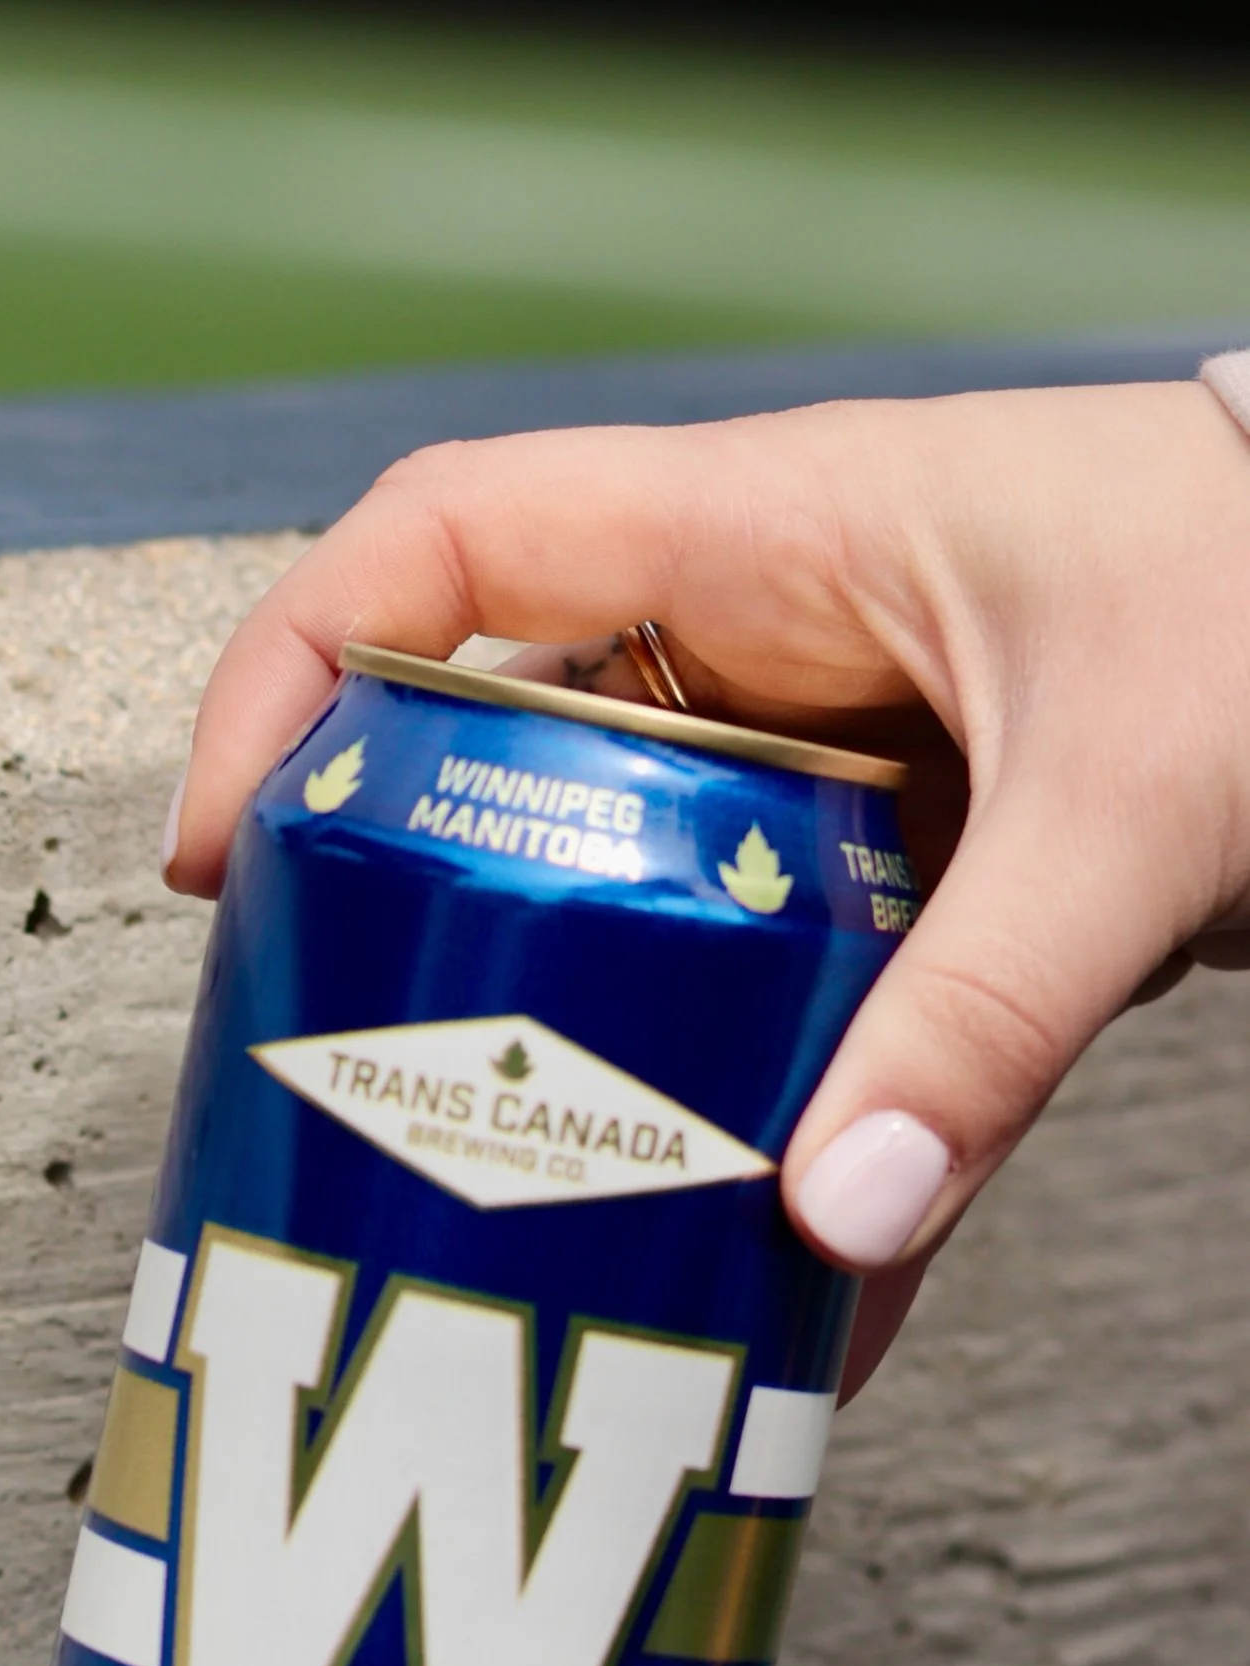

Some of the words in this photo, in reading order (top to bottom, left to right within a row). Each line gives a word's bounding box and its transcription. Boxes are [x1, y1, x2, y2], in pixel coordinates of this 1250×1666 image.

[437, 755, 643, 834] WINNIPEG
[407, 795, 642, 883] MANITOBA
[328, 1051, 475, 1122] TRANS
[491, 1093, 686, 1170] CANADA
[407, 1122, 537, 1173] BREWING
